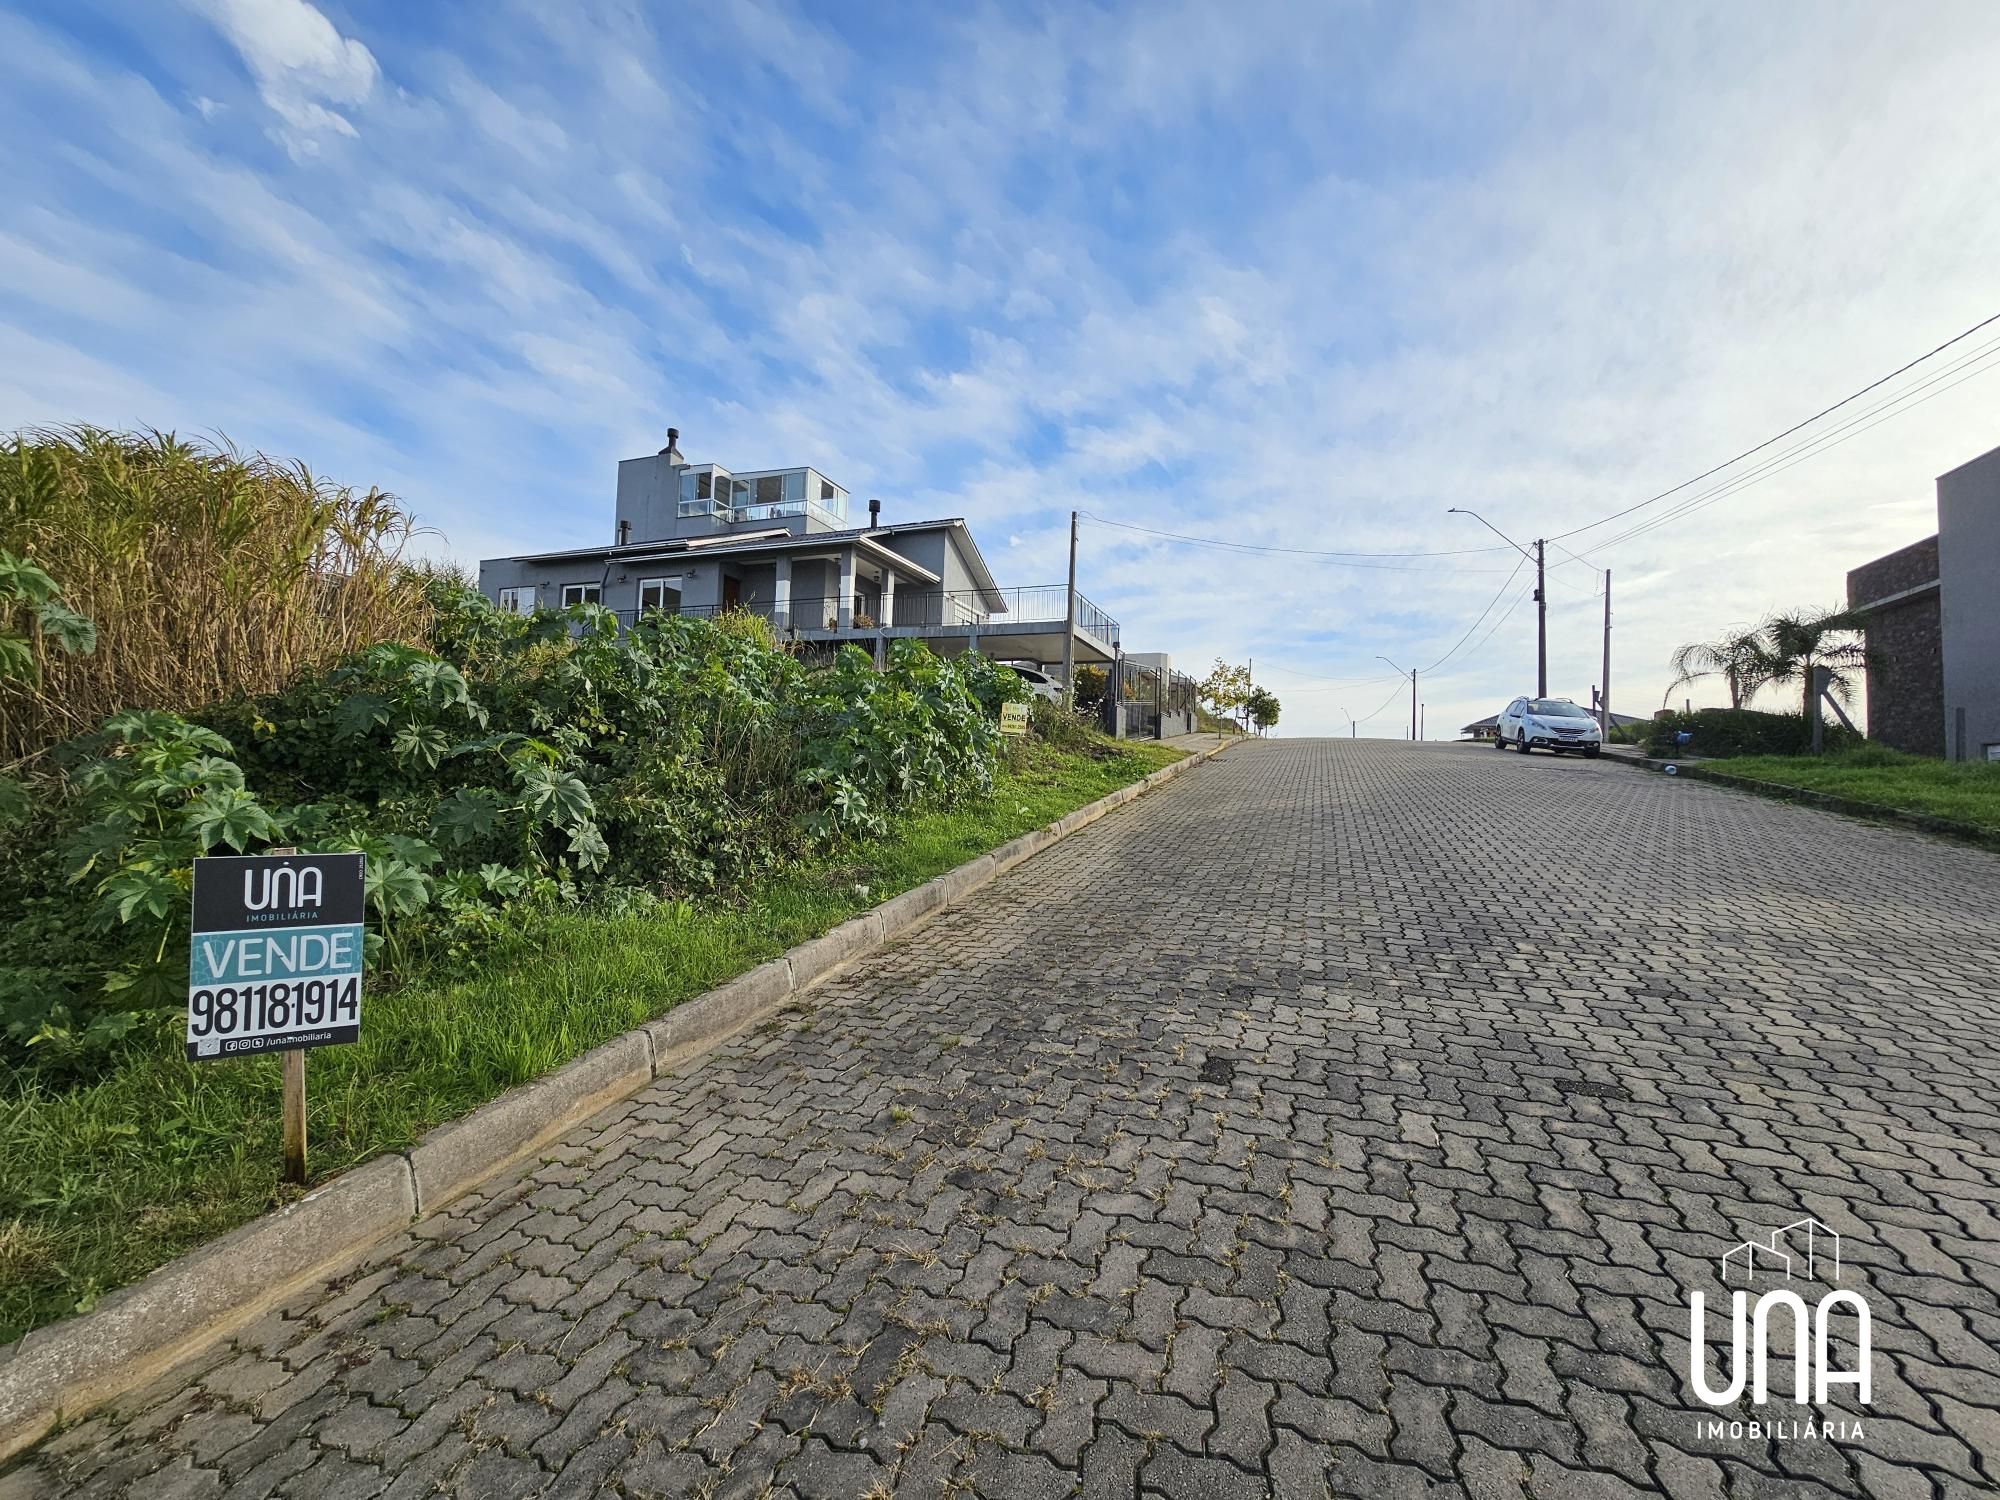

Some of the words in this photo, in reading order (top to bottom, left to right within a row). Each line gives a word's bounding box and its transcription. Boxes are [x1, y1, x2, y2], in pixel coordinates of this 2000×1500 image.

[1003, 713, 1026, 721] VENDE
[244, 866, 323, 911] UNA
[246, 911, 319, 923] IMOBILIÁRIA
[203, 933, 353, 979] VENDE
